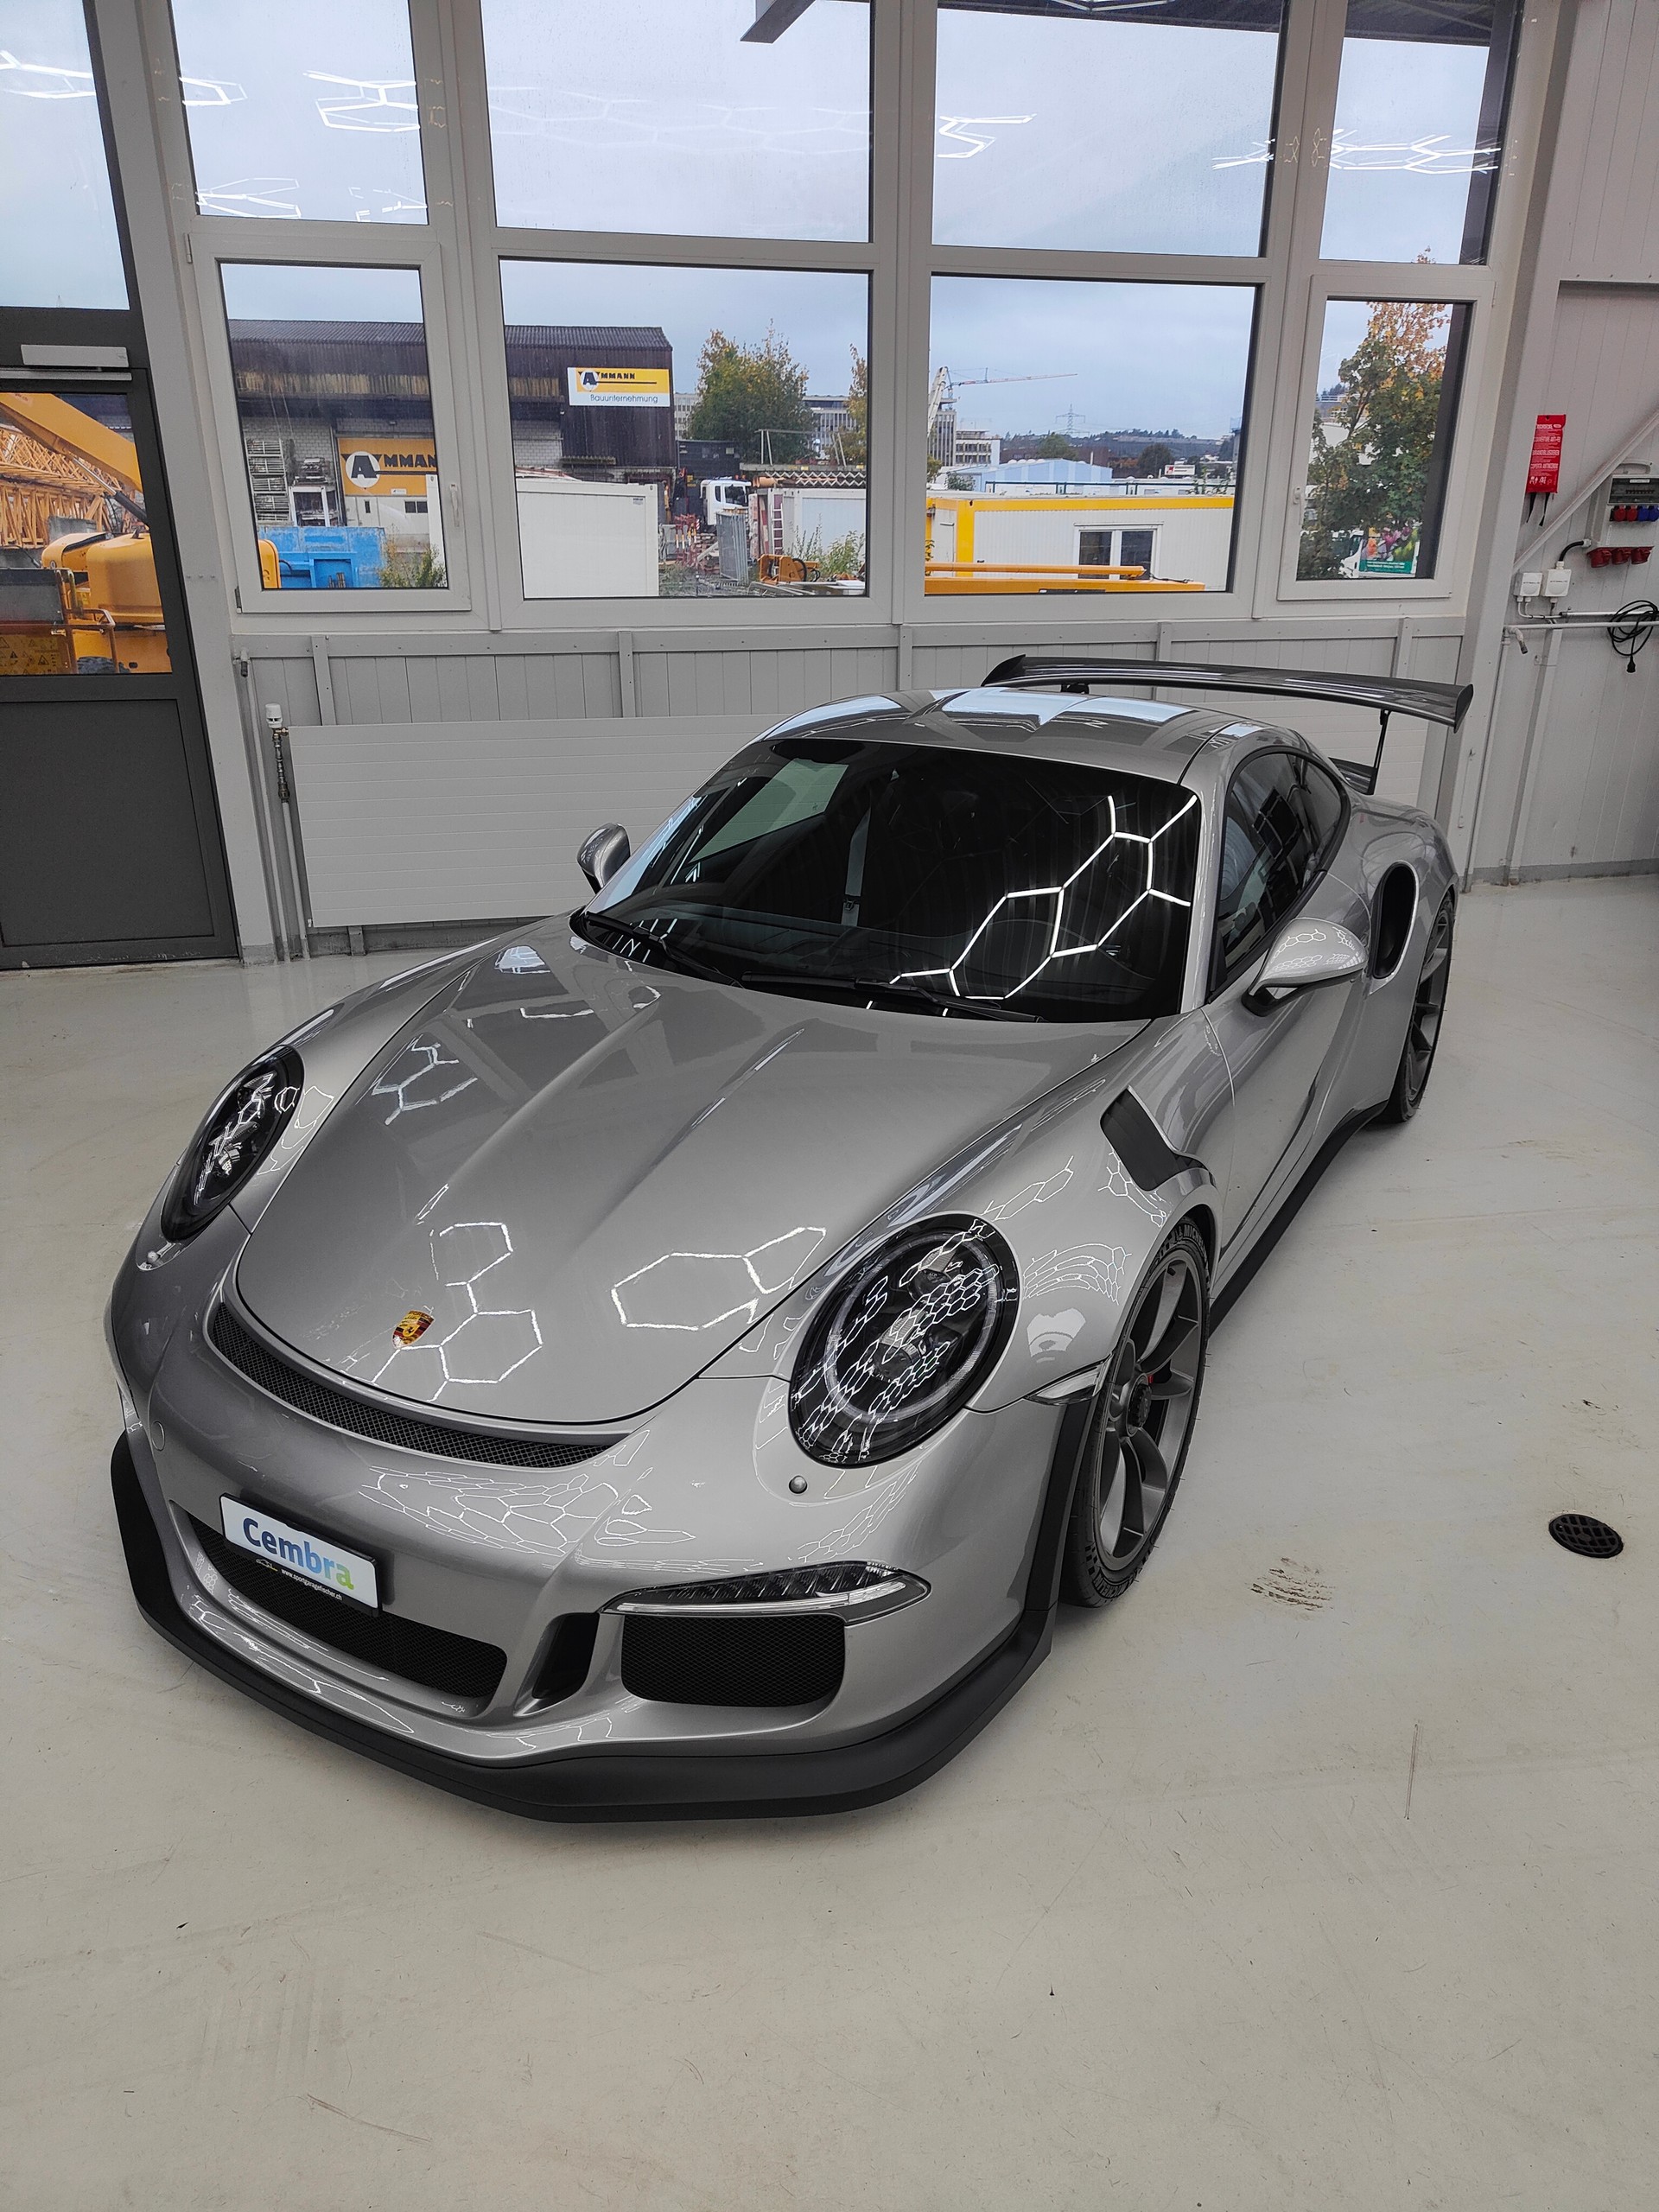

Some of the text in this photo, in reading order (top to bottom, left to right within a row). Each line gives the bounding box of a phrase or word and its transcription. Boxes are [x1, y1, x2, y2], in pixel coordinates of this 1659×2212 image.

[579, 372, 635, 385] AMMANN
[590, 394, 658, 404] Bauunternehmung
[243, 1517, 354, 1590] Cembra
